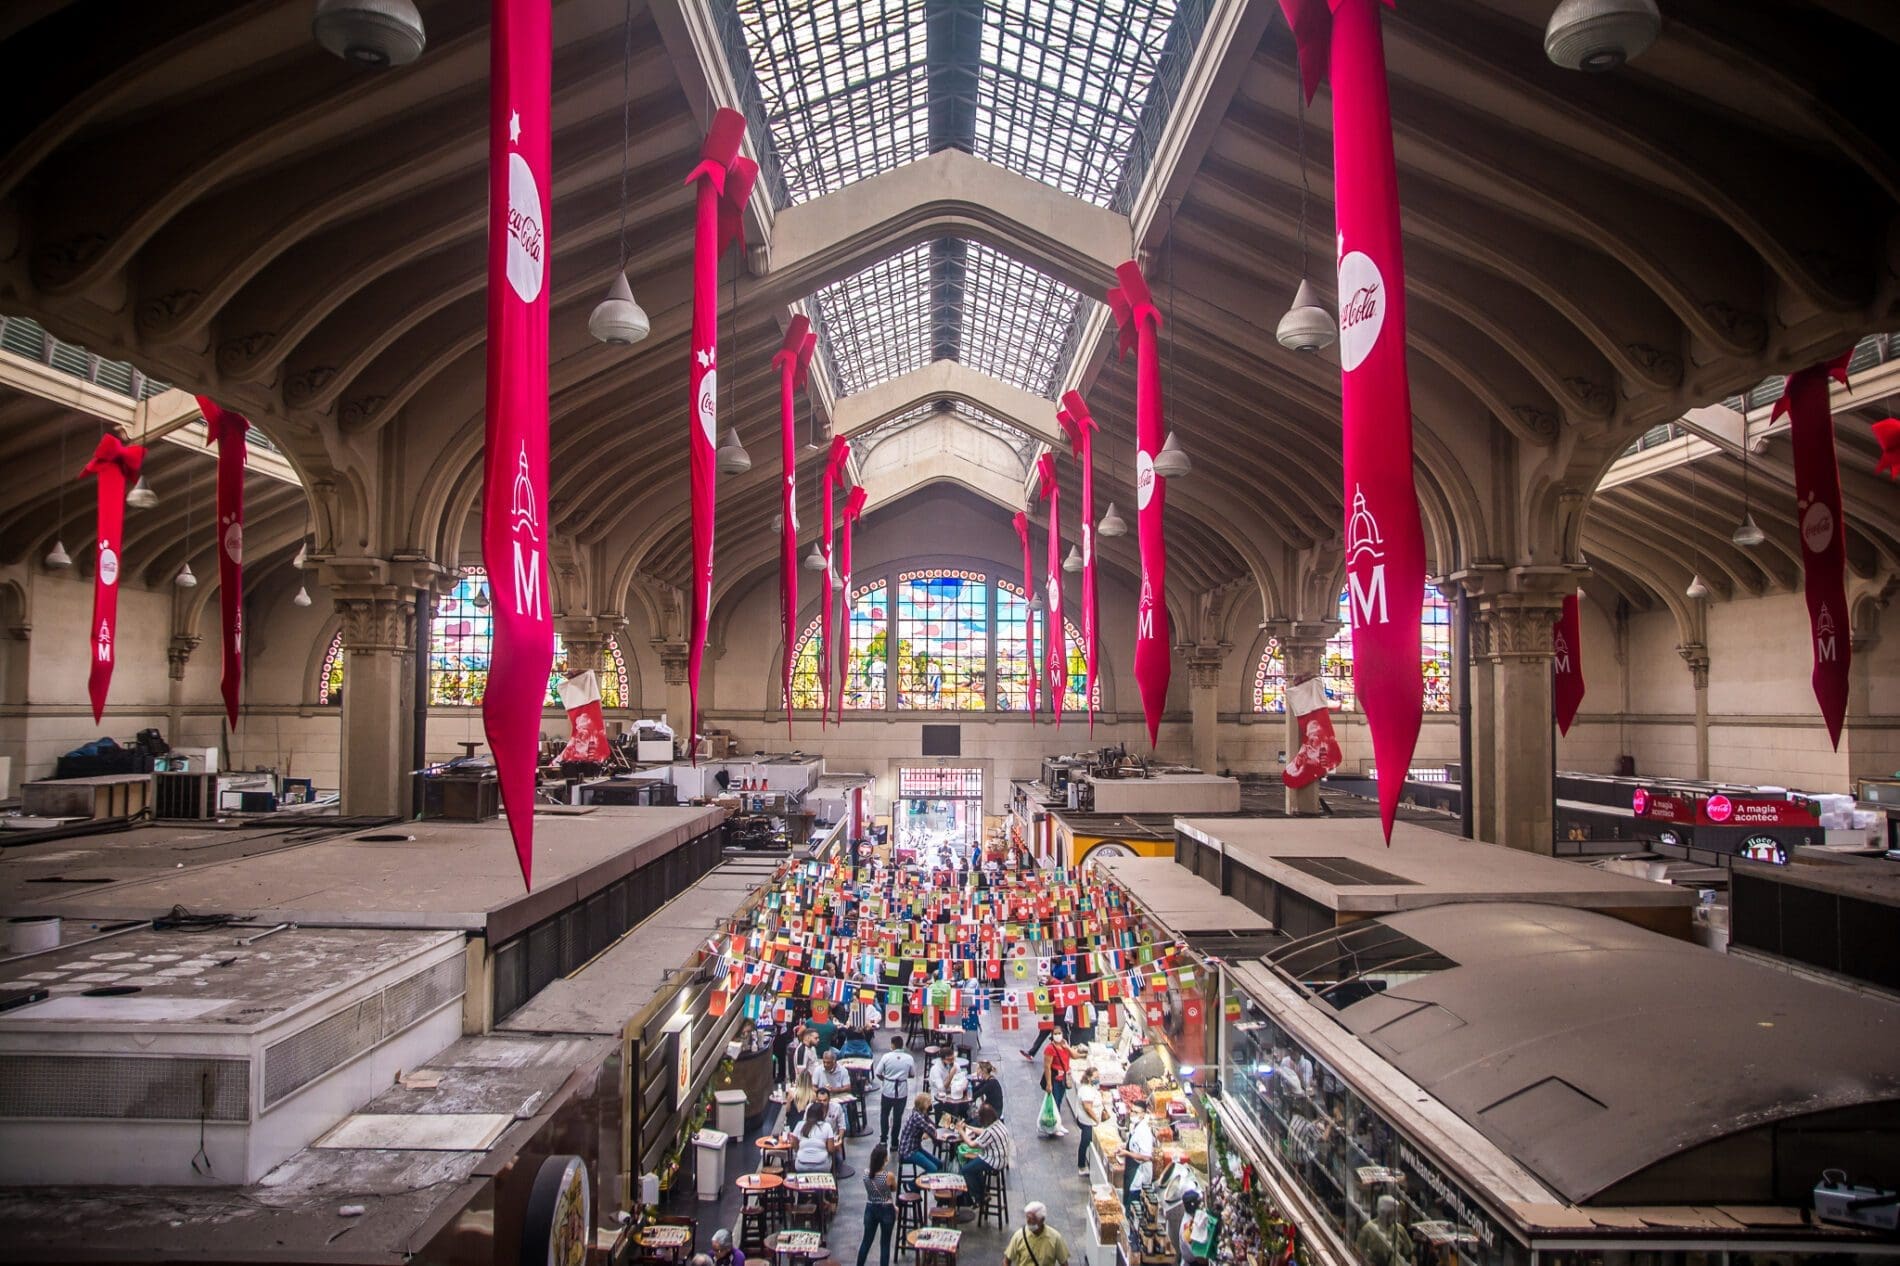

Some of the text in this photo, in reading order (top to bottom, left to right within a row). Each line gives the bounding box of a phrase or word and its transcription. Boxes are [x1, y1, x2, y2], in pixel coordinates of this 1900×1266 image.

[512, 541, 542, 621] M
[1349, 564, 1389, 629] M
[1138, 609, 1154, 640] M
[98, 643, 110, 662] M
[1817, 635, 1836, 663] M
[1554, 655, 1571, 674] M
[1050, 669, 1061, 688] M
[1735, 814, 1779, 822] acontece
[1737, 804, 1777, 814] A magia
